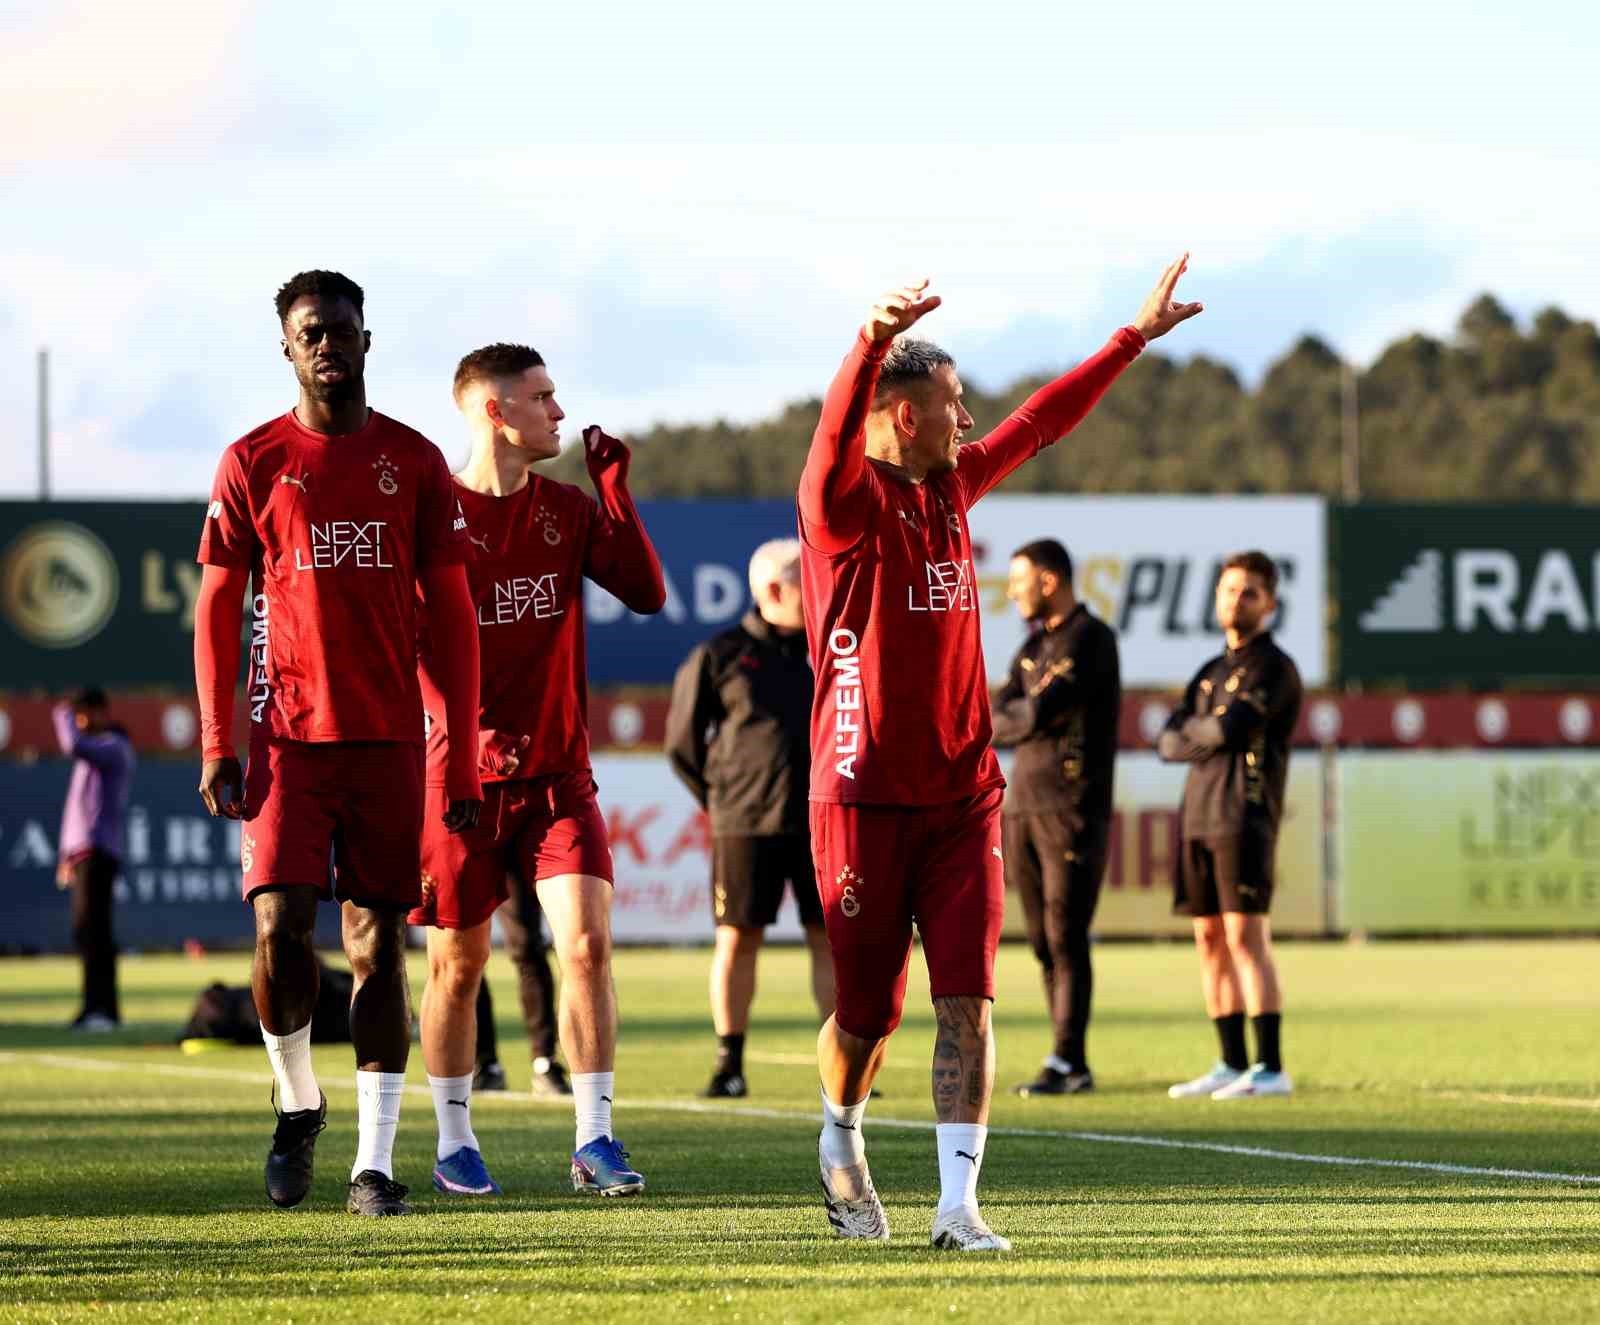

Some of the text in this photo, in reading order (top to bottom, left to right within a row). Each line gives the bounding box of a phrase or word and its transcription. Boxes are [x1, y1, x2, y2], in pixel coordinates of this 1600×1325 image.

[310, 521, 387, 545] NEXT
[295, 545, 393, 570] LEVEL
[925, 559, 970, 586] NEXT
[494, 573, 559, 601] NEXT
[1455, 549, 1600, 632] RA
[477, 596, 565, 626] LEVEL
